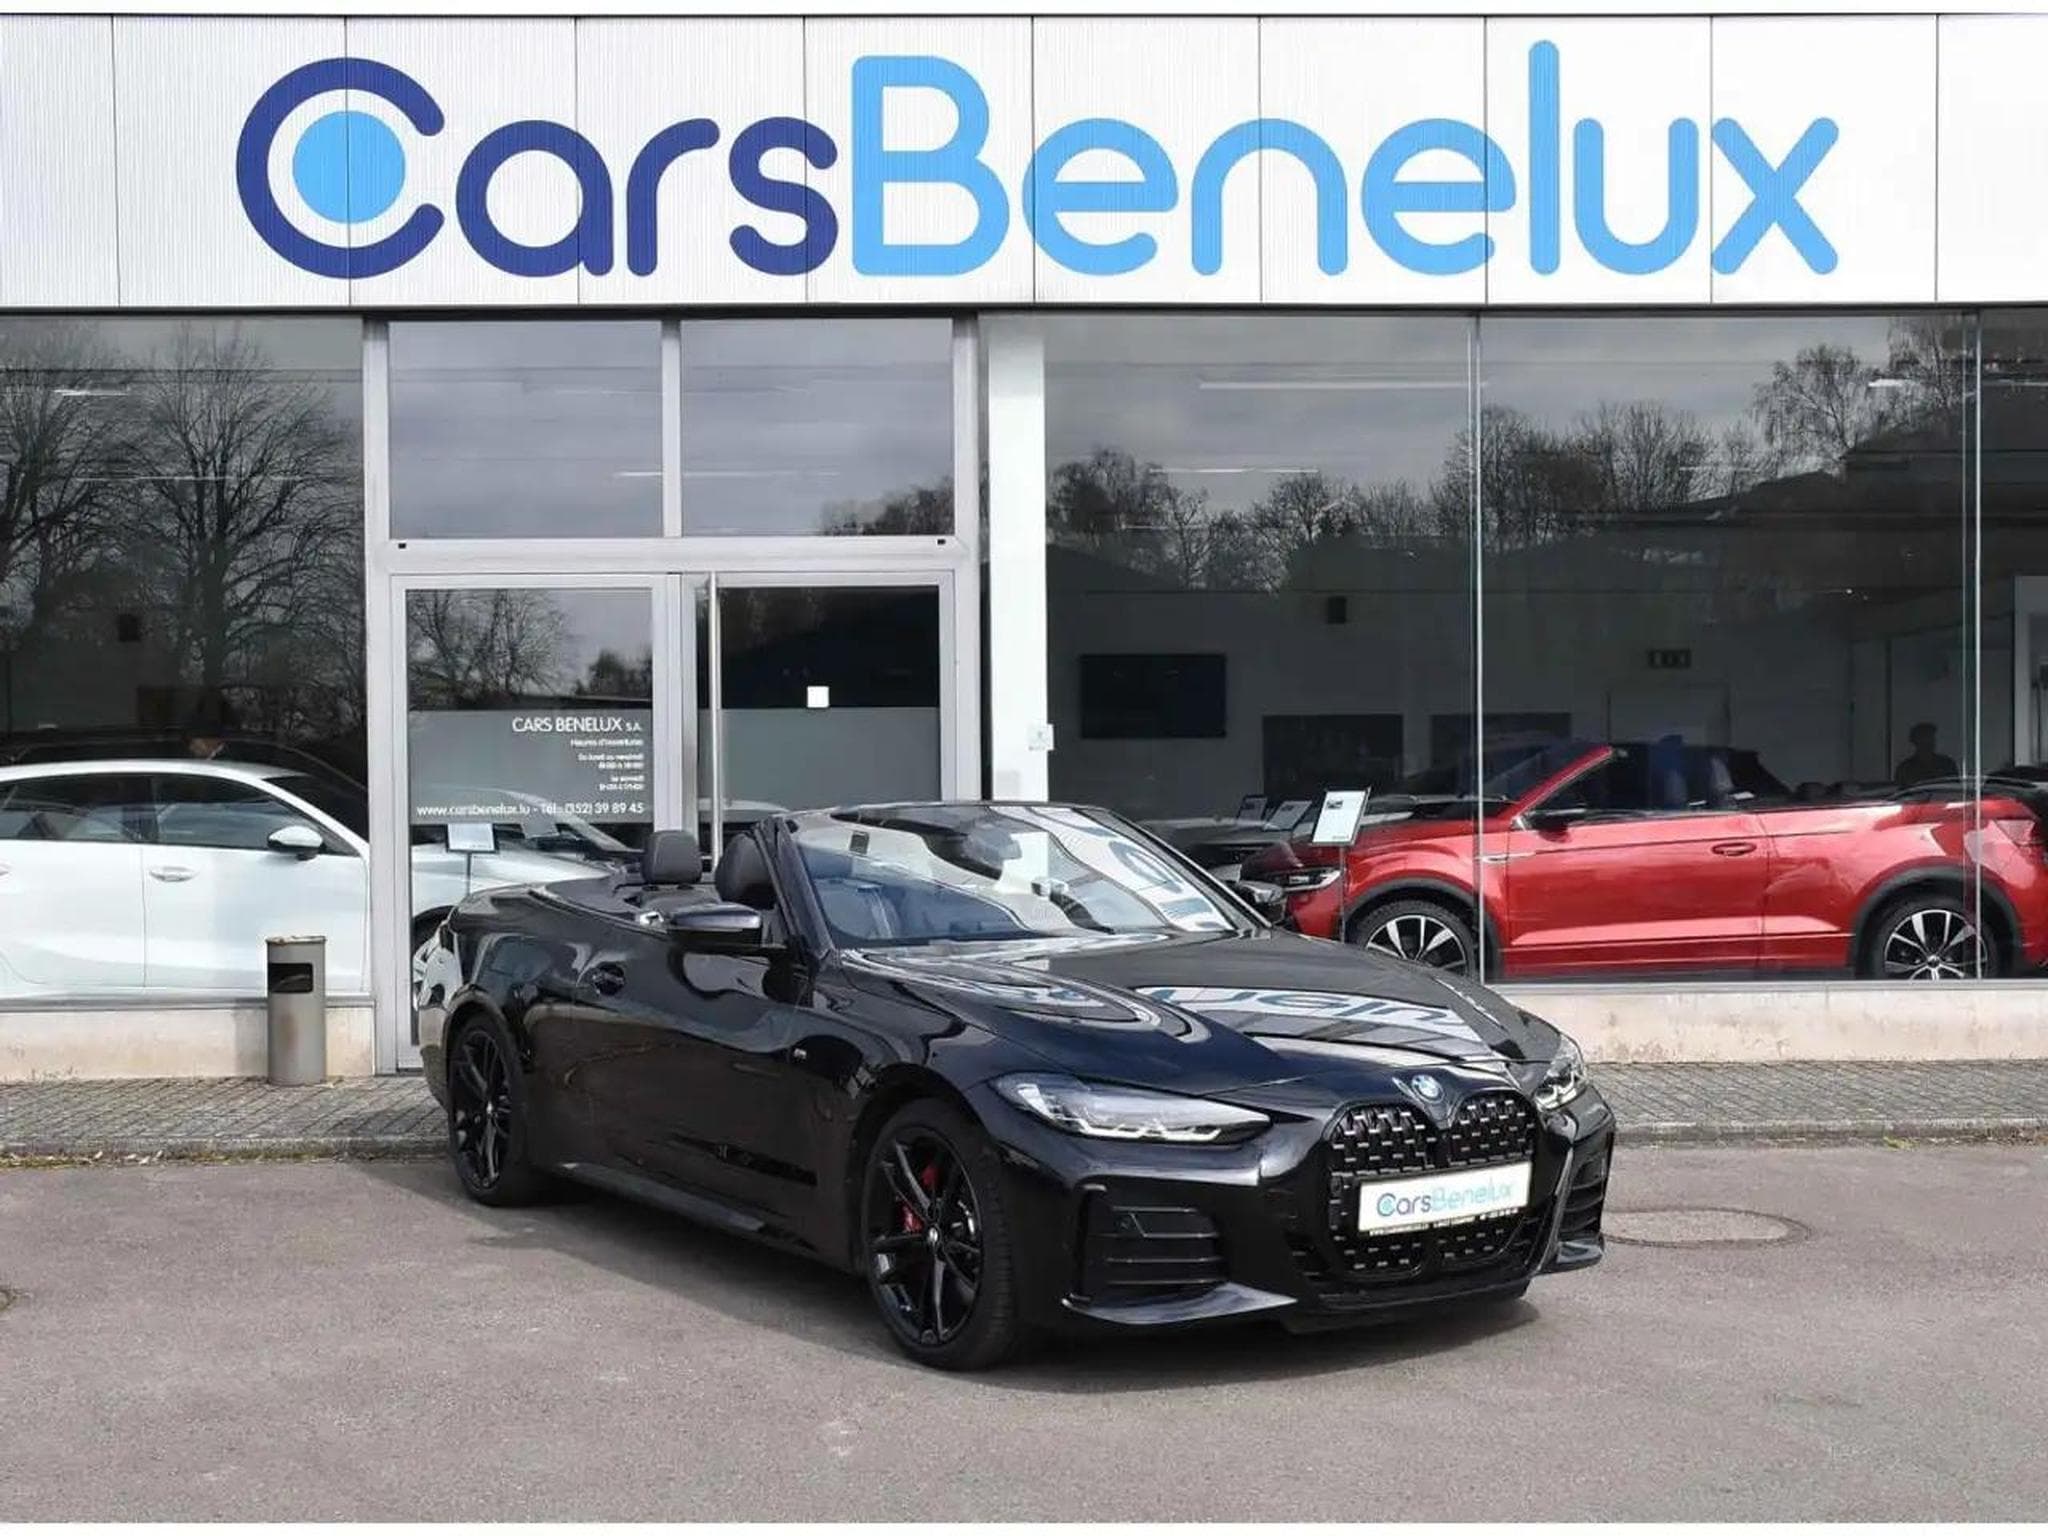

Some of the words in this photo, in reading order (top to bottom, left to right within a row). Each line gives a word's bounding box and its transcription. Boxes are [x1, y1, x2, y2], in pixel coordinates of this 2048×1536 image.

[237, 41, 1839, 277] CarsBenelux
[512, 717, 553, 732] CARS
[556, 717, 623, 732] BENELUX
[594, 802, 609, 814] 39
[611, 802, 627, 814] 89
[629, 802, 645, 814] 45
[1376, 1177, 1514, 1217] CarsBenelux
